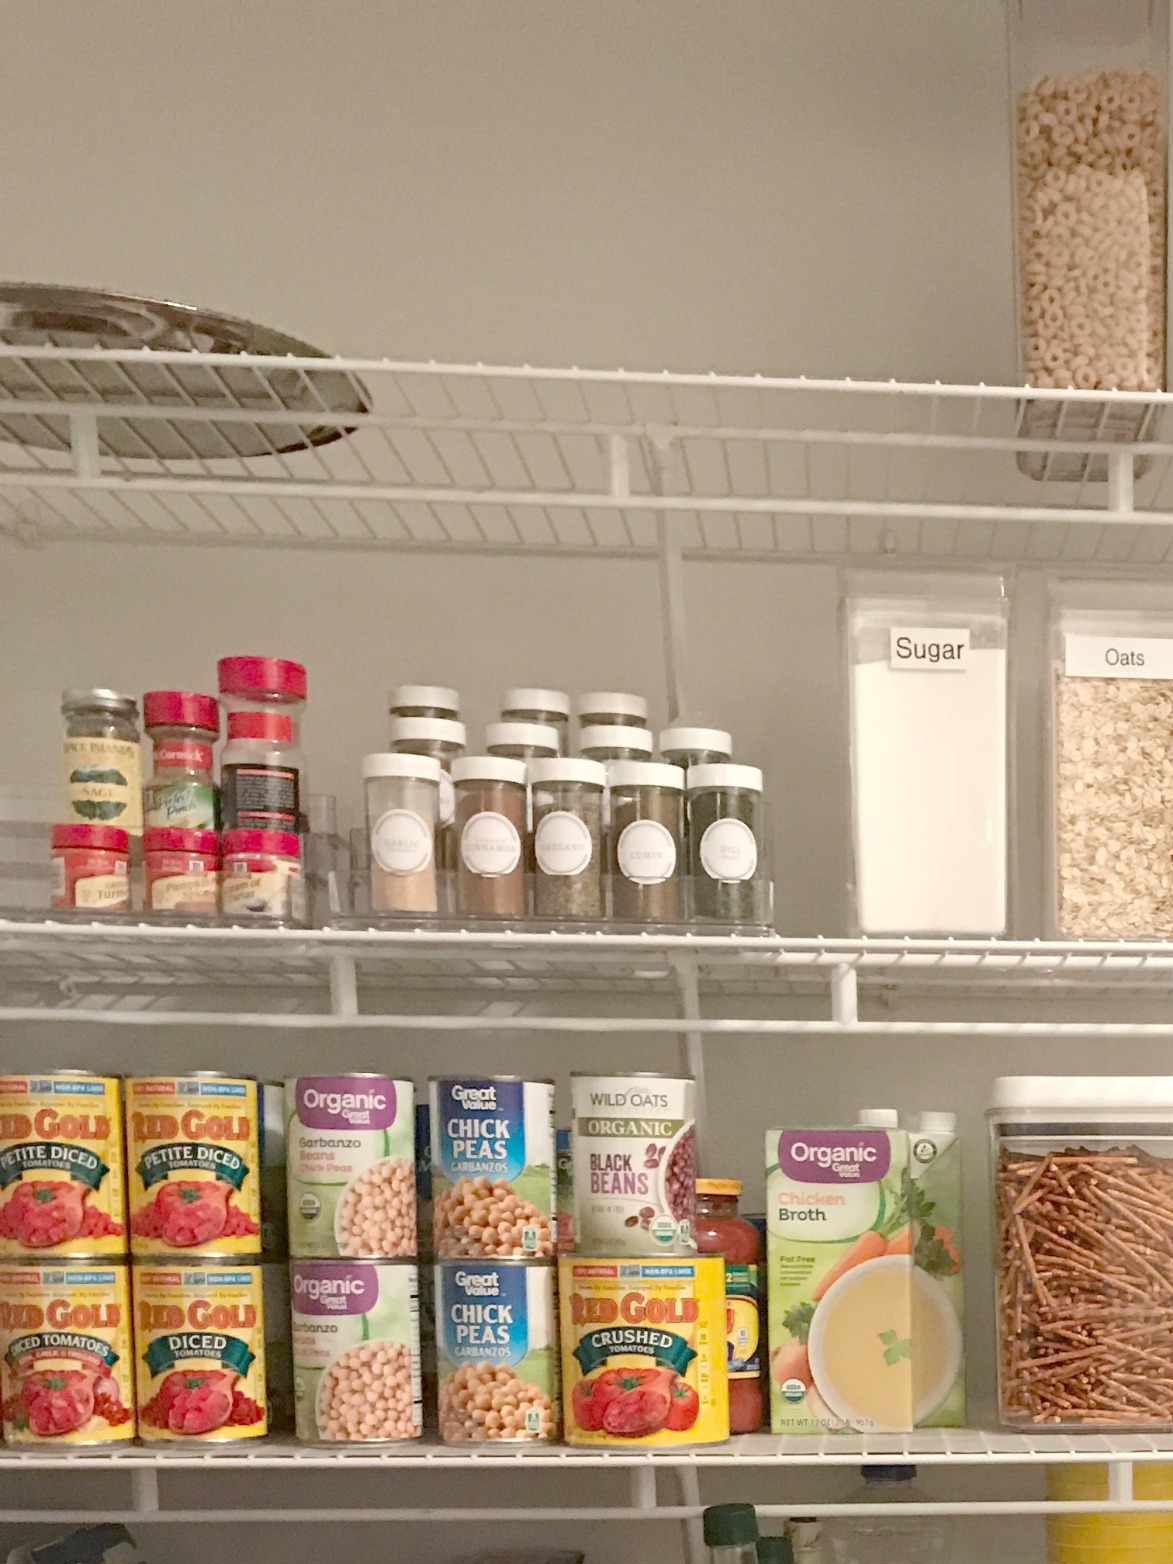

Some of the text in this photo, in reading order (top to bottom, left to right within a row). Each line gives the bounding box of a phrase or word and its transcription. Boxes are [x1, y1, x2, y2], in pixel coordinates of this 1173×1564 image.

[896, 637, 965, 664] Sugar
[1105, 648, 1145, 667] Oats
[629, 850, 664, 860] CUMIN
[303, 1088, 387, 1115] Organic
[451, 1084, 497, 1101] Great
[590, 1092, 669, 1108] WILD OATS
[462, 1098, 497, 1111] Value
[0, 1108, 111, 1141] ED GOLD
[131, 1109, 251, 1144] RED GOLD
[447, 1118, 511, 1139] CHICK
[587, 1119, 673, 1137] ORGANIC
[298, 1137, 362, 1149] Garbanzo
[452, 1139, 508, 1160] PEAS
[1, 1145, 98, 1170] PETITE DICED
[144, 1146, 240, 1170] PETITE DICED
[590, 1153, 632, 1172] BLACK
[790, 1141, 878, 1169] Organic
[168, 1160, 217, 1170] TOMATOES
[450, 1161, 509, 1173] GARBANZOS
[590, 1171, 649, 1196] BEANS
[778, 1191, 847, 1206] Chicken
[778, 1208, 827, 1222] Broth
[779, 1255, 816, 1264] Fat Free
[293, 1274, 365, 1300] Organic
[455, 1270, 500, 1288] Great
[464, 1285, 500, 1297] Value
[46, 1298, 121, 1330] GOLD
[138, 1299, 257, 1333] RED GOLD
[450, 1303, 514, 1325] CHICK
[569, 1291, 700, 1327] RED GOLD
[168, 1334, 228, 1351] DICED
[455, 1324, 511, 1345] PEAS
[591, 1328, 674, 1349] CRUSHED
[10, 1335, 41, 1357] DICED
[42, 1333, 111, 1358] TOMATOES
[173, 1349, 222, 1358] TOMATOES
[454, 1346, 512, 1358] GARBANZOS
[608, 1344, 656, 1355] TOMATOES
